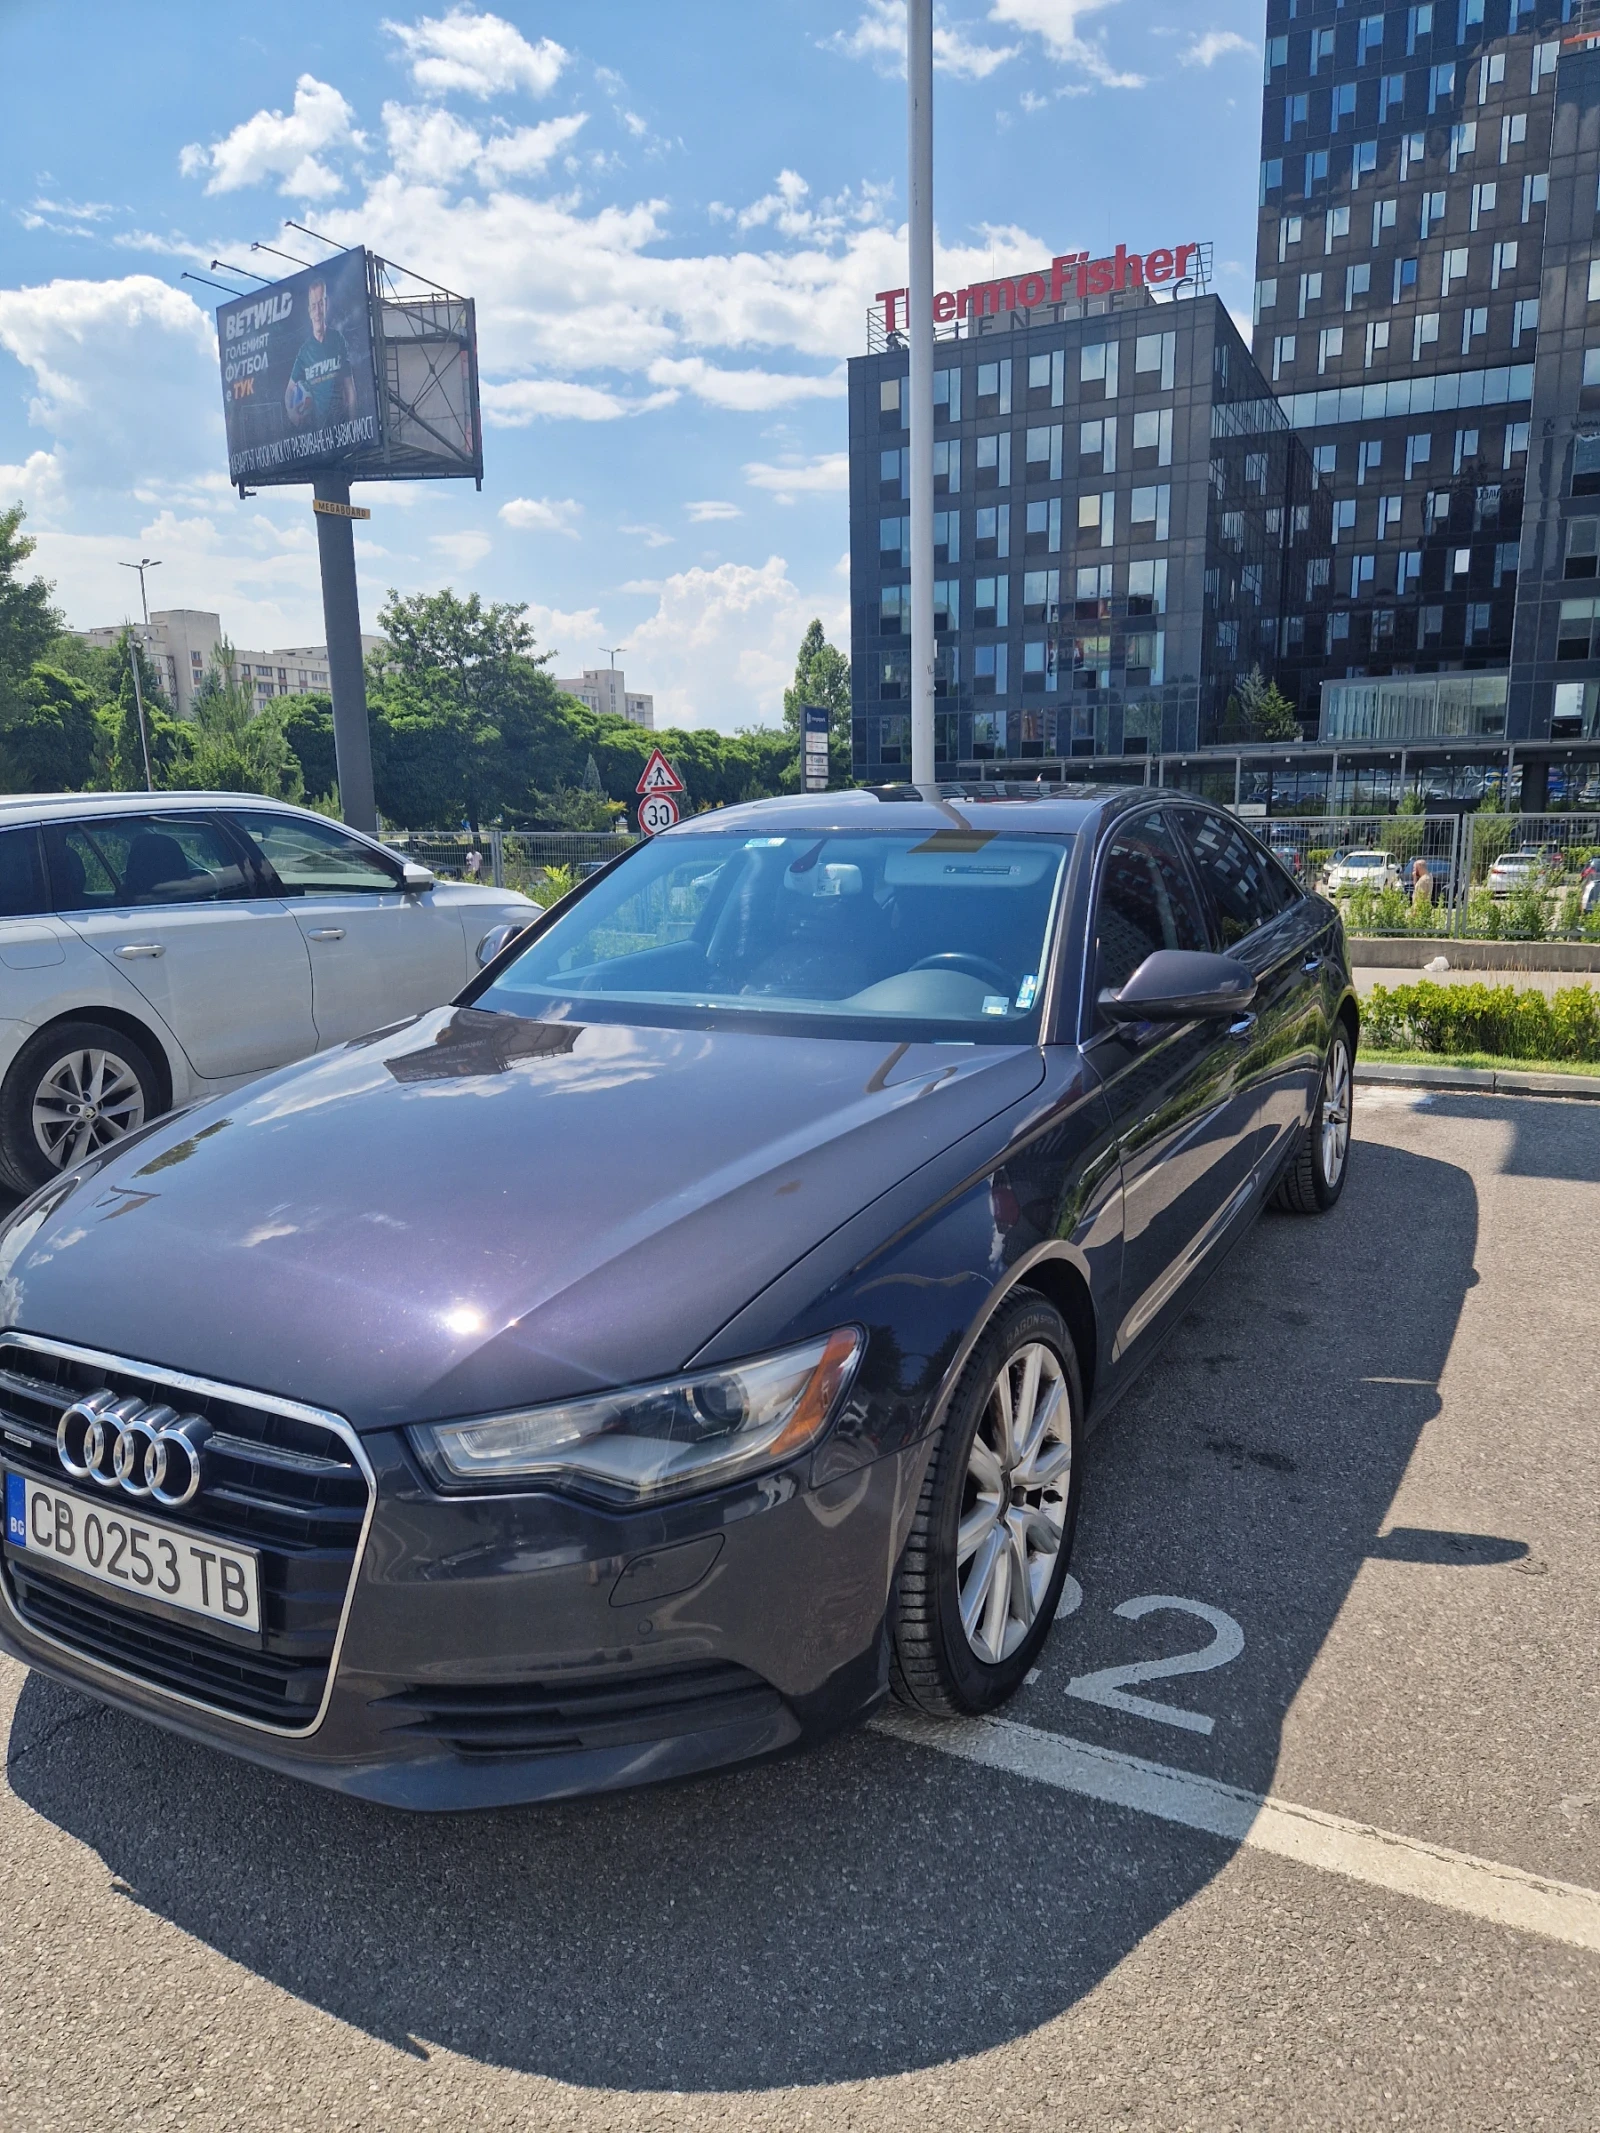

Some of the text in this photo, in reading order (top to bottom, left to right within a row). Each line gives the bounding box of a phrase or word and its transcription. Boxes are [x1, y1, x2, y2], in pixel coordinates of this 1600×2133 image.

[226, 292, 293, 341] BETWILD
[226, 333, 269, 361] ГОЛЕМИЯТ
[225, 352, 268, 383] ФУТБОЛ
[234, 378, 254, 400] ТУК
[270, 440, 285, 465] РИСК
[291, 429, 326, 459] РАЗВИВАНЕ
[324, 426, 335, 450] НА
[333, 415, 374, 448] ЗАВИСИМОСТ
[318, 502, 366, 518] MEGABOARD
[11, 1491, 249, 1617] BG CB 0253 TB
